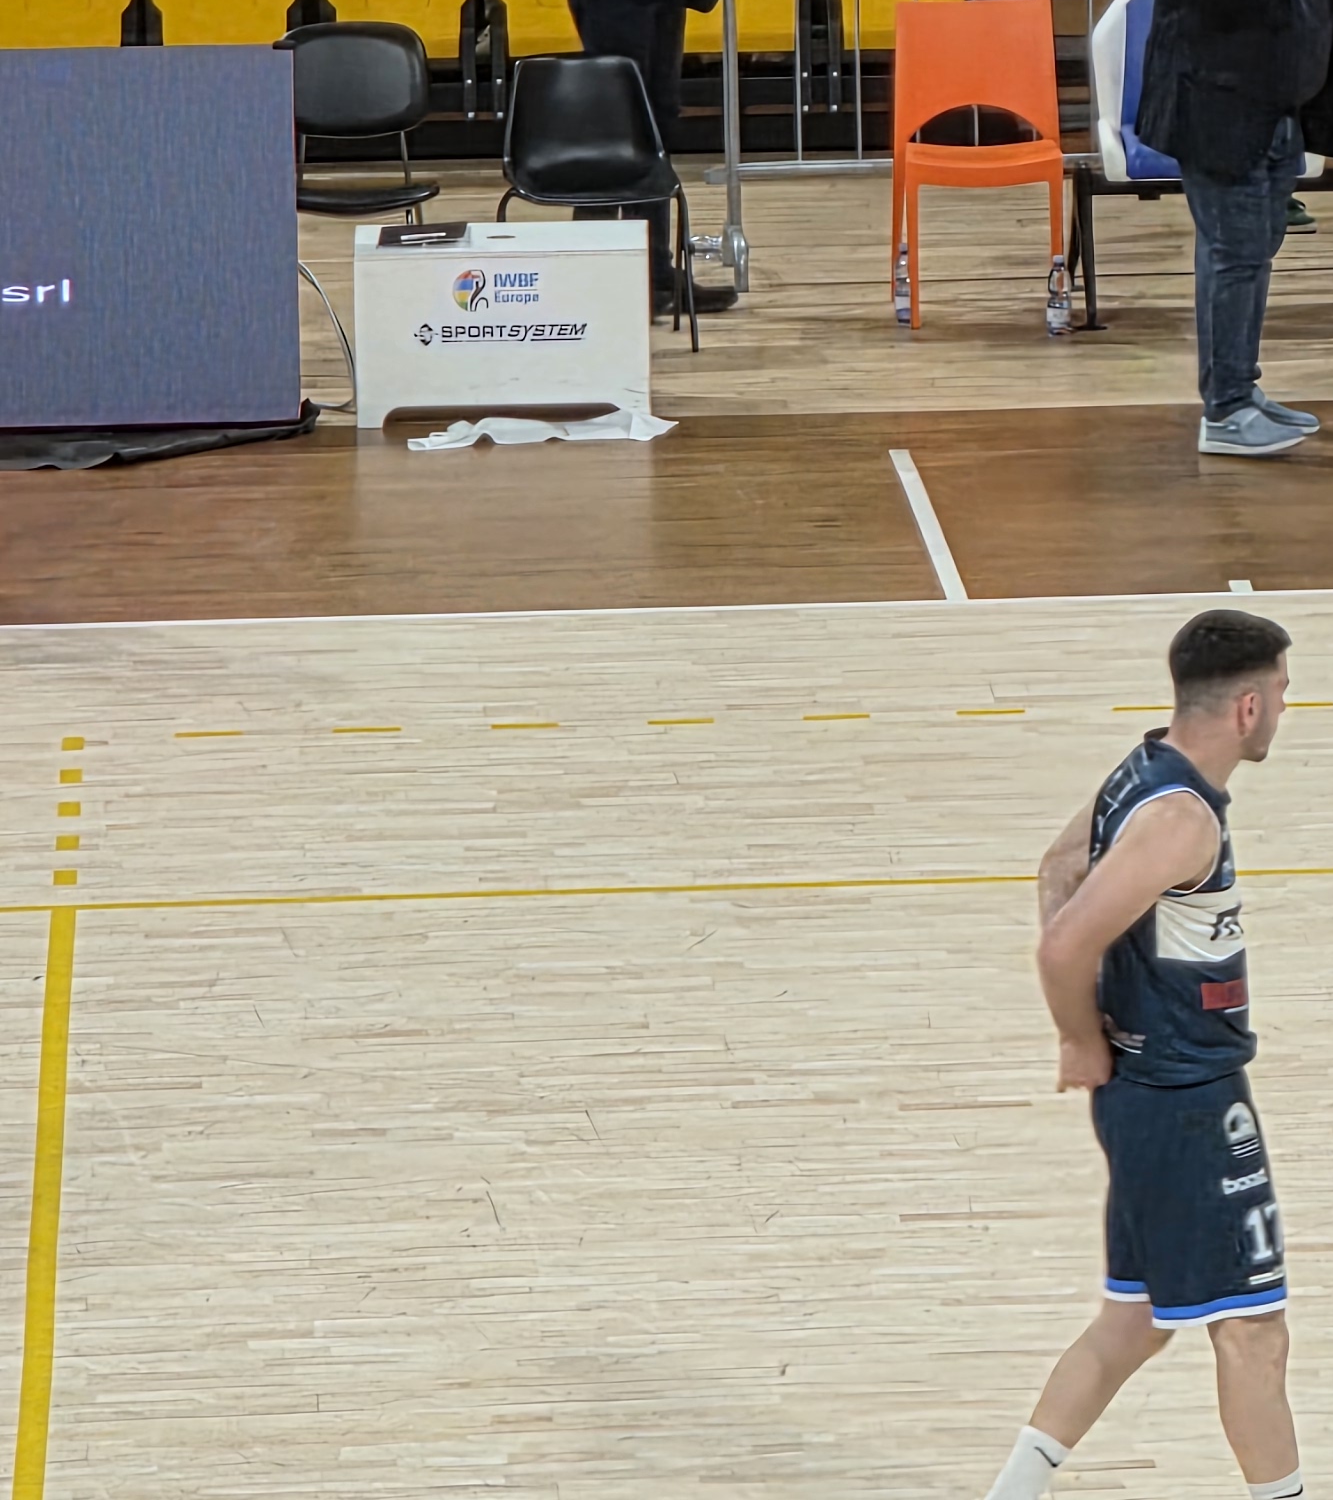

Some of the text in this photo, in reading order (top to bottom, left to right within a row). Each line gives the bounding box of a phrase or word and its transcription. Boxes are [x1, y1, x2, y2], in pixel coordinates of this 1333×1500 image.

[494, 272, 539, 288] IWBF
[1, 278, 71, 303] srl
[494, 291, 539, 304] Europe
